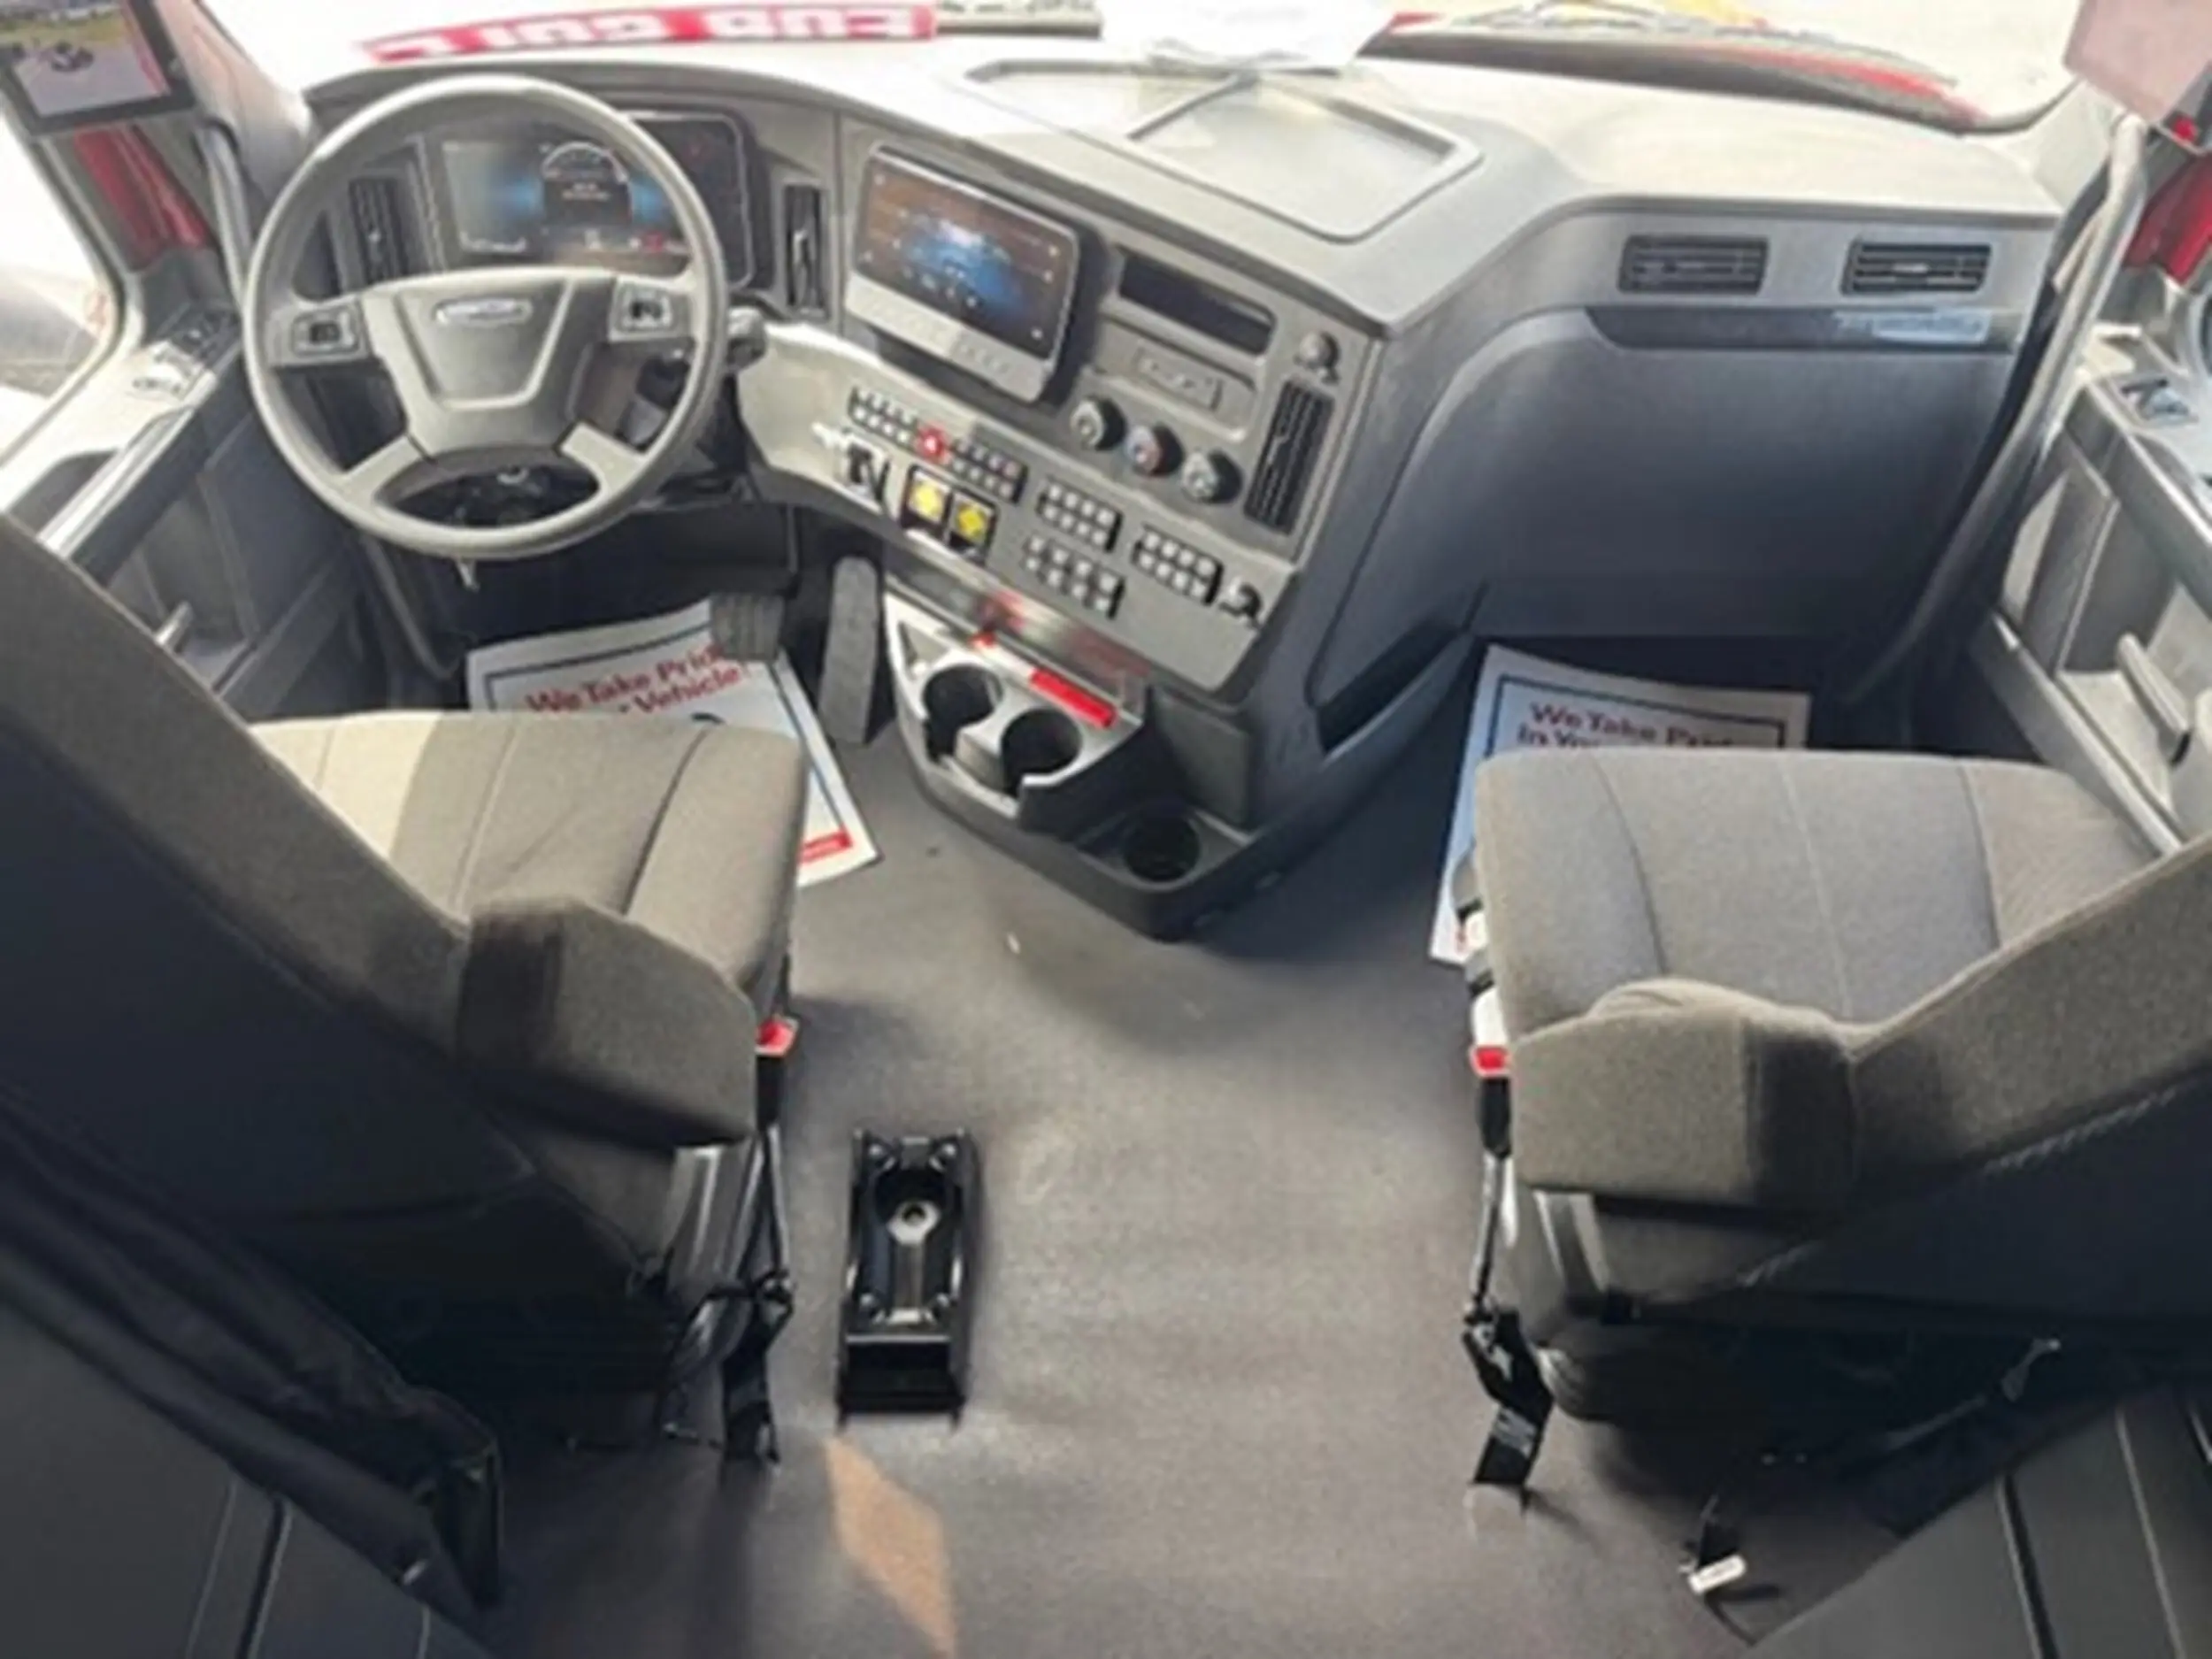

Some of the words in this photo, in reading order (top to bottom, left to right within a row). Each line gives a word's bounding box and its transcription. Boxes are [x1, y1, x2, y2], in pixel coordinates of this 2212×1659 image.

[525, 687, 582, 712] We
[582, 673, 652, 704] Take
[1517, 721, 1548, 747] In
[1529, 702, 1582, 729] We
[1588, 710, 1658, 738] Take
